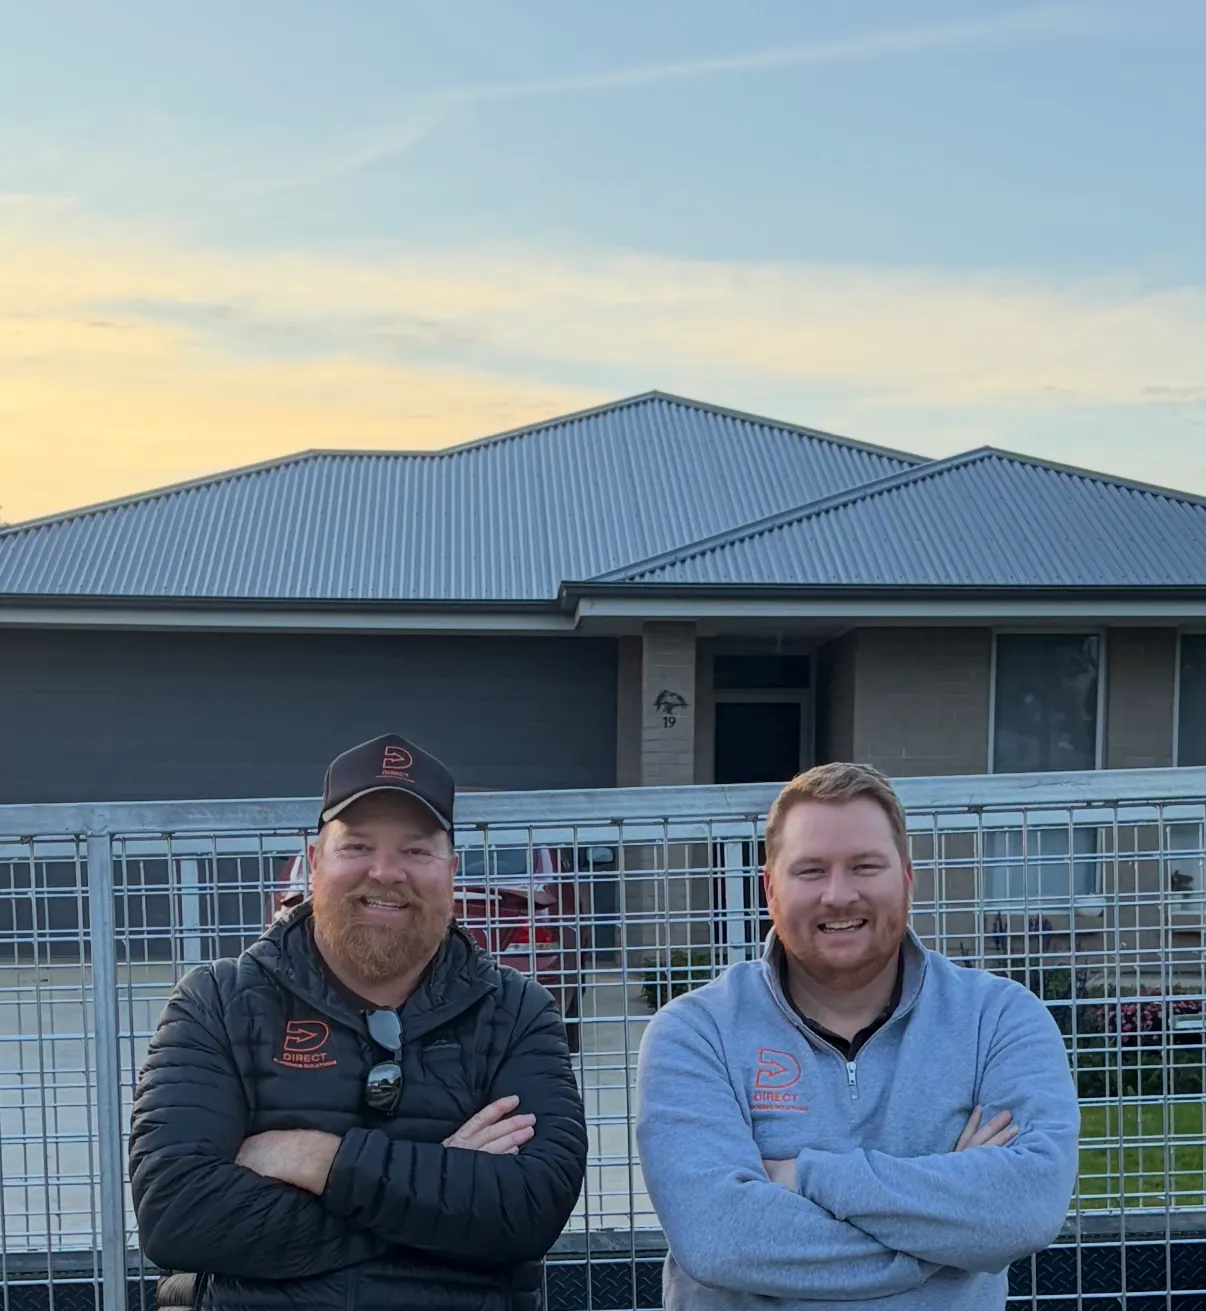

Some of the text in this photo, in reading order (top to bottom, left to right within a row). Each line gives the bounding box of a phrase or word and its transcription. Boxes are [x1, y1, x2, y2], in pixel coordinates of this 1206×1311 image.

[663, 716, 677, 729] 19
[382, 770, 409, 778] DIRECT
[283, 1053, 328, 1062] DIRECT
[754, 1092, 799, 1102] DIRECT
